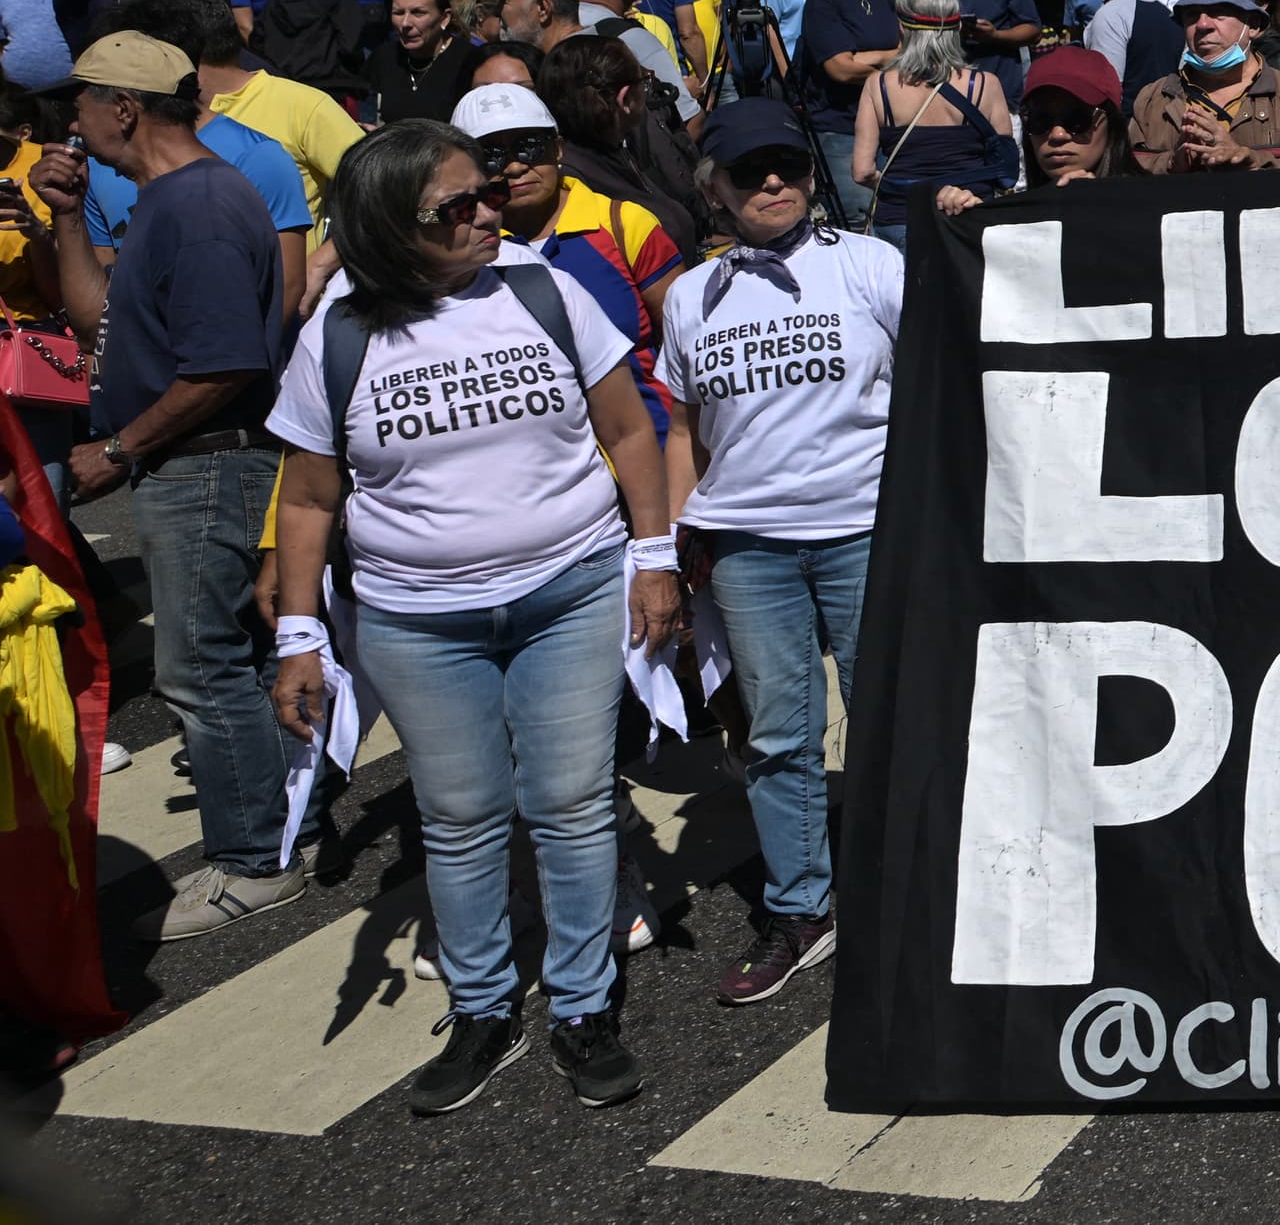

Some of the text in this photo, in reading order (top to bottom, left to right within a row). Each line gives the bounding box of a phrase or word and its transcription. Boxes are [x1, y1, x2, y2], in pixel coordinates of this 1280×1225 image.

[695, 313, 841, 352] LIBEREN A TODOS
[695, 331, 842, 377] LOS PRESOS
[370, 342, 550, 394] LIBEREN A TODOS
[374, 362, 557, 416] LOS PRESOS
[696, 357, 846, 407] POLÍTICOS
[376, 387, 566, 448] POLÍTICOS
